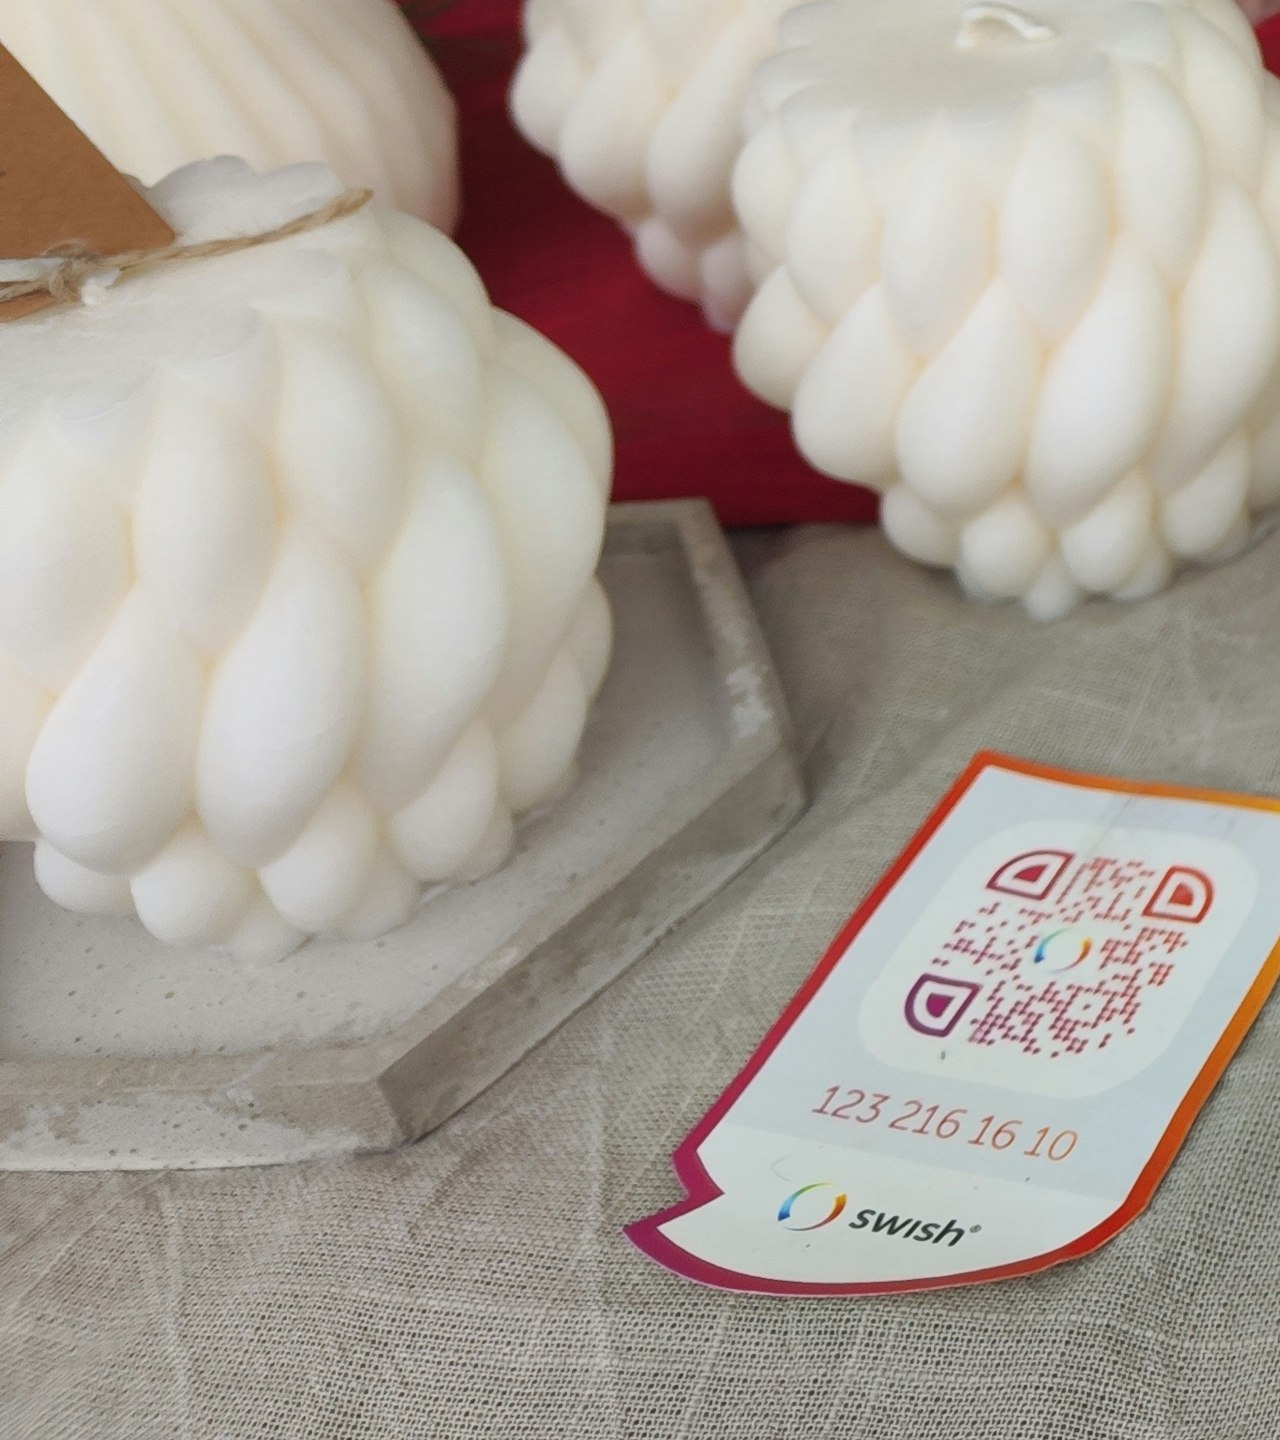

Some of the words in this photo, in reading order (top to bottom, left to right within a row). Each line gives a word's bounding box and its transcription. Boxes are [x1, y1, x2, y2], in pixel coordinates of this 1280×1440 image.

[811, 1085, 890, 1124] 123
[889, 1100, 967, 1140] 216
[967, 1115, 1023, 1150] 16
[1023, 1127, 1079, 1161] 10
